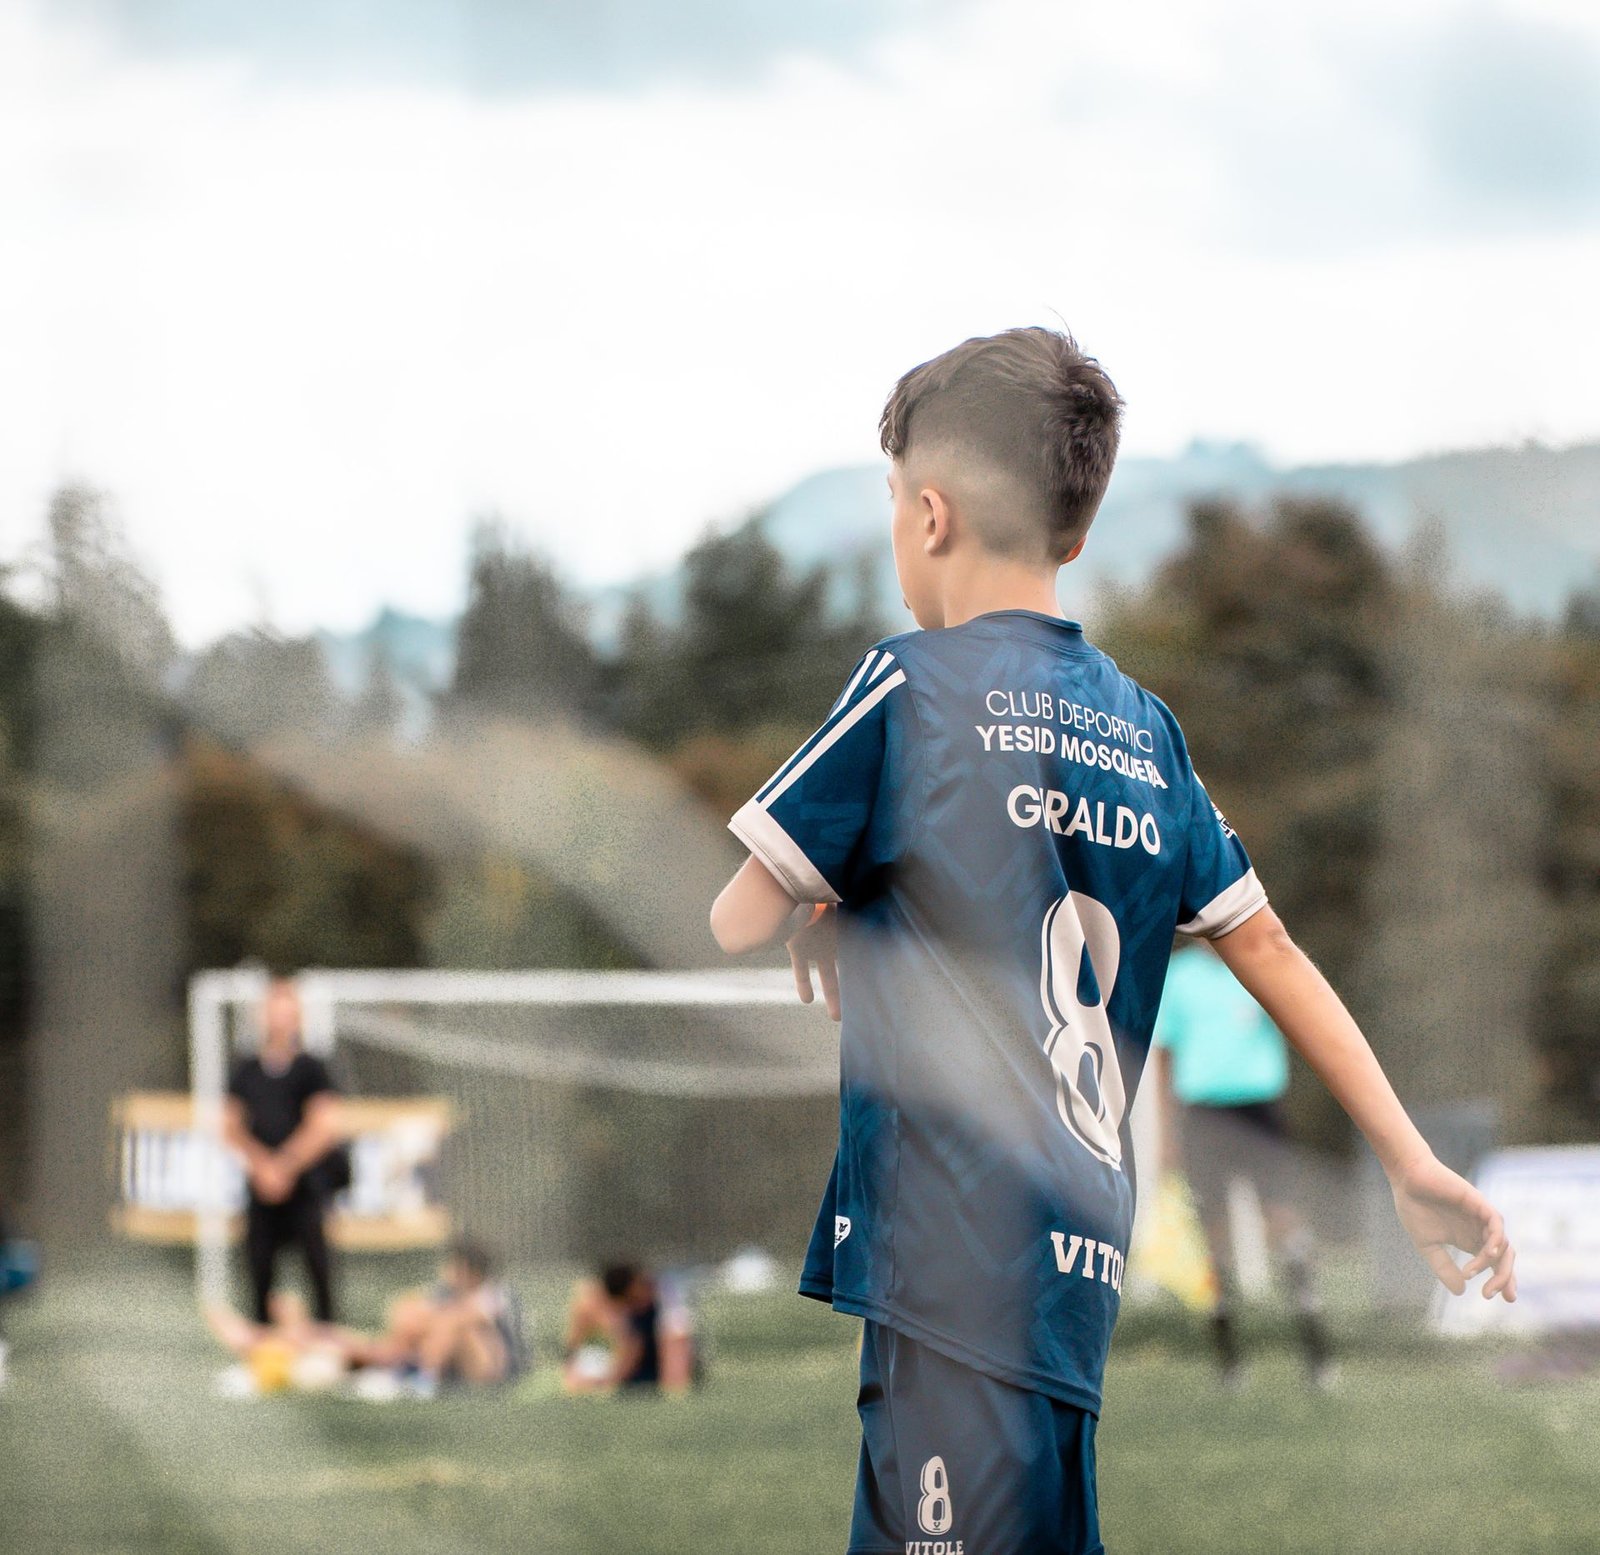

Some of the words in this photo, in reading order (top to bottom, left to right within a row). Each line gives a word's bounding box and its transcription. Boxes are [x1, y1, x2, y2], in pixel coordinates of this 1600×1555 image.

[986, 690, 1054, 720] CLUB
[975, 725, 1056, 755] YESID
[1040, 890, 1126, 1171] 8
[917, 1455, 953, 1536] 8
